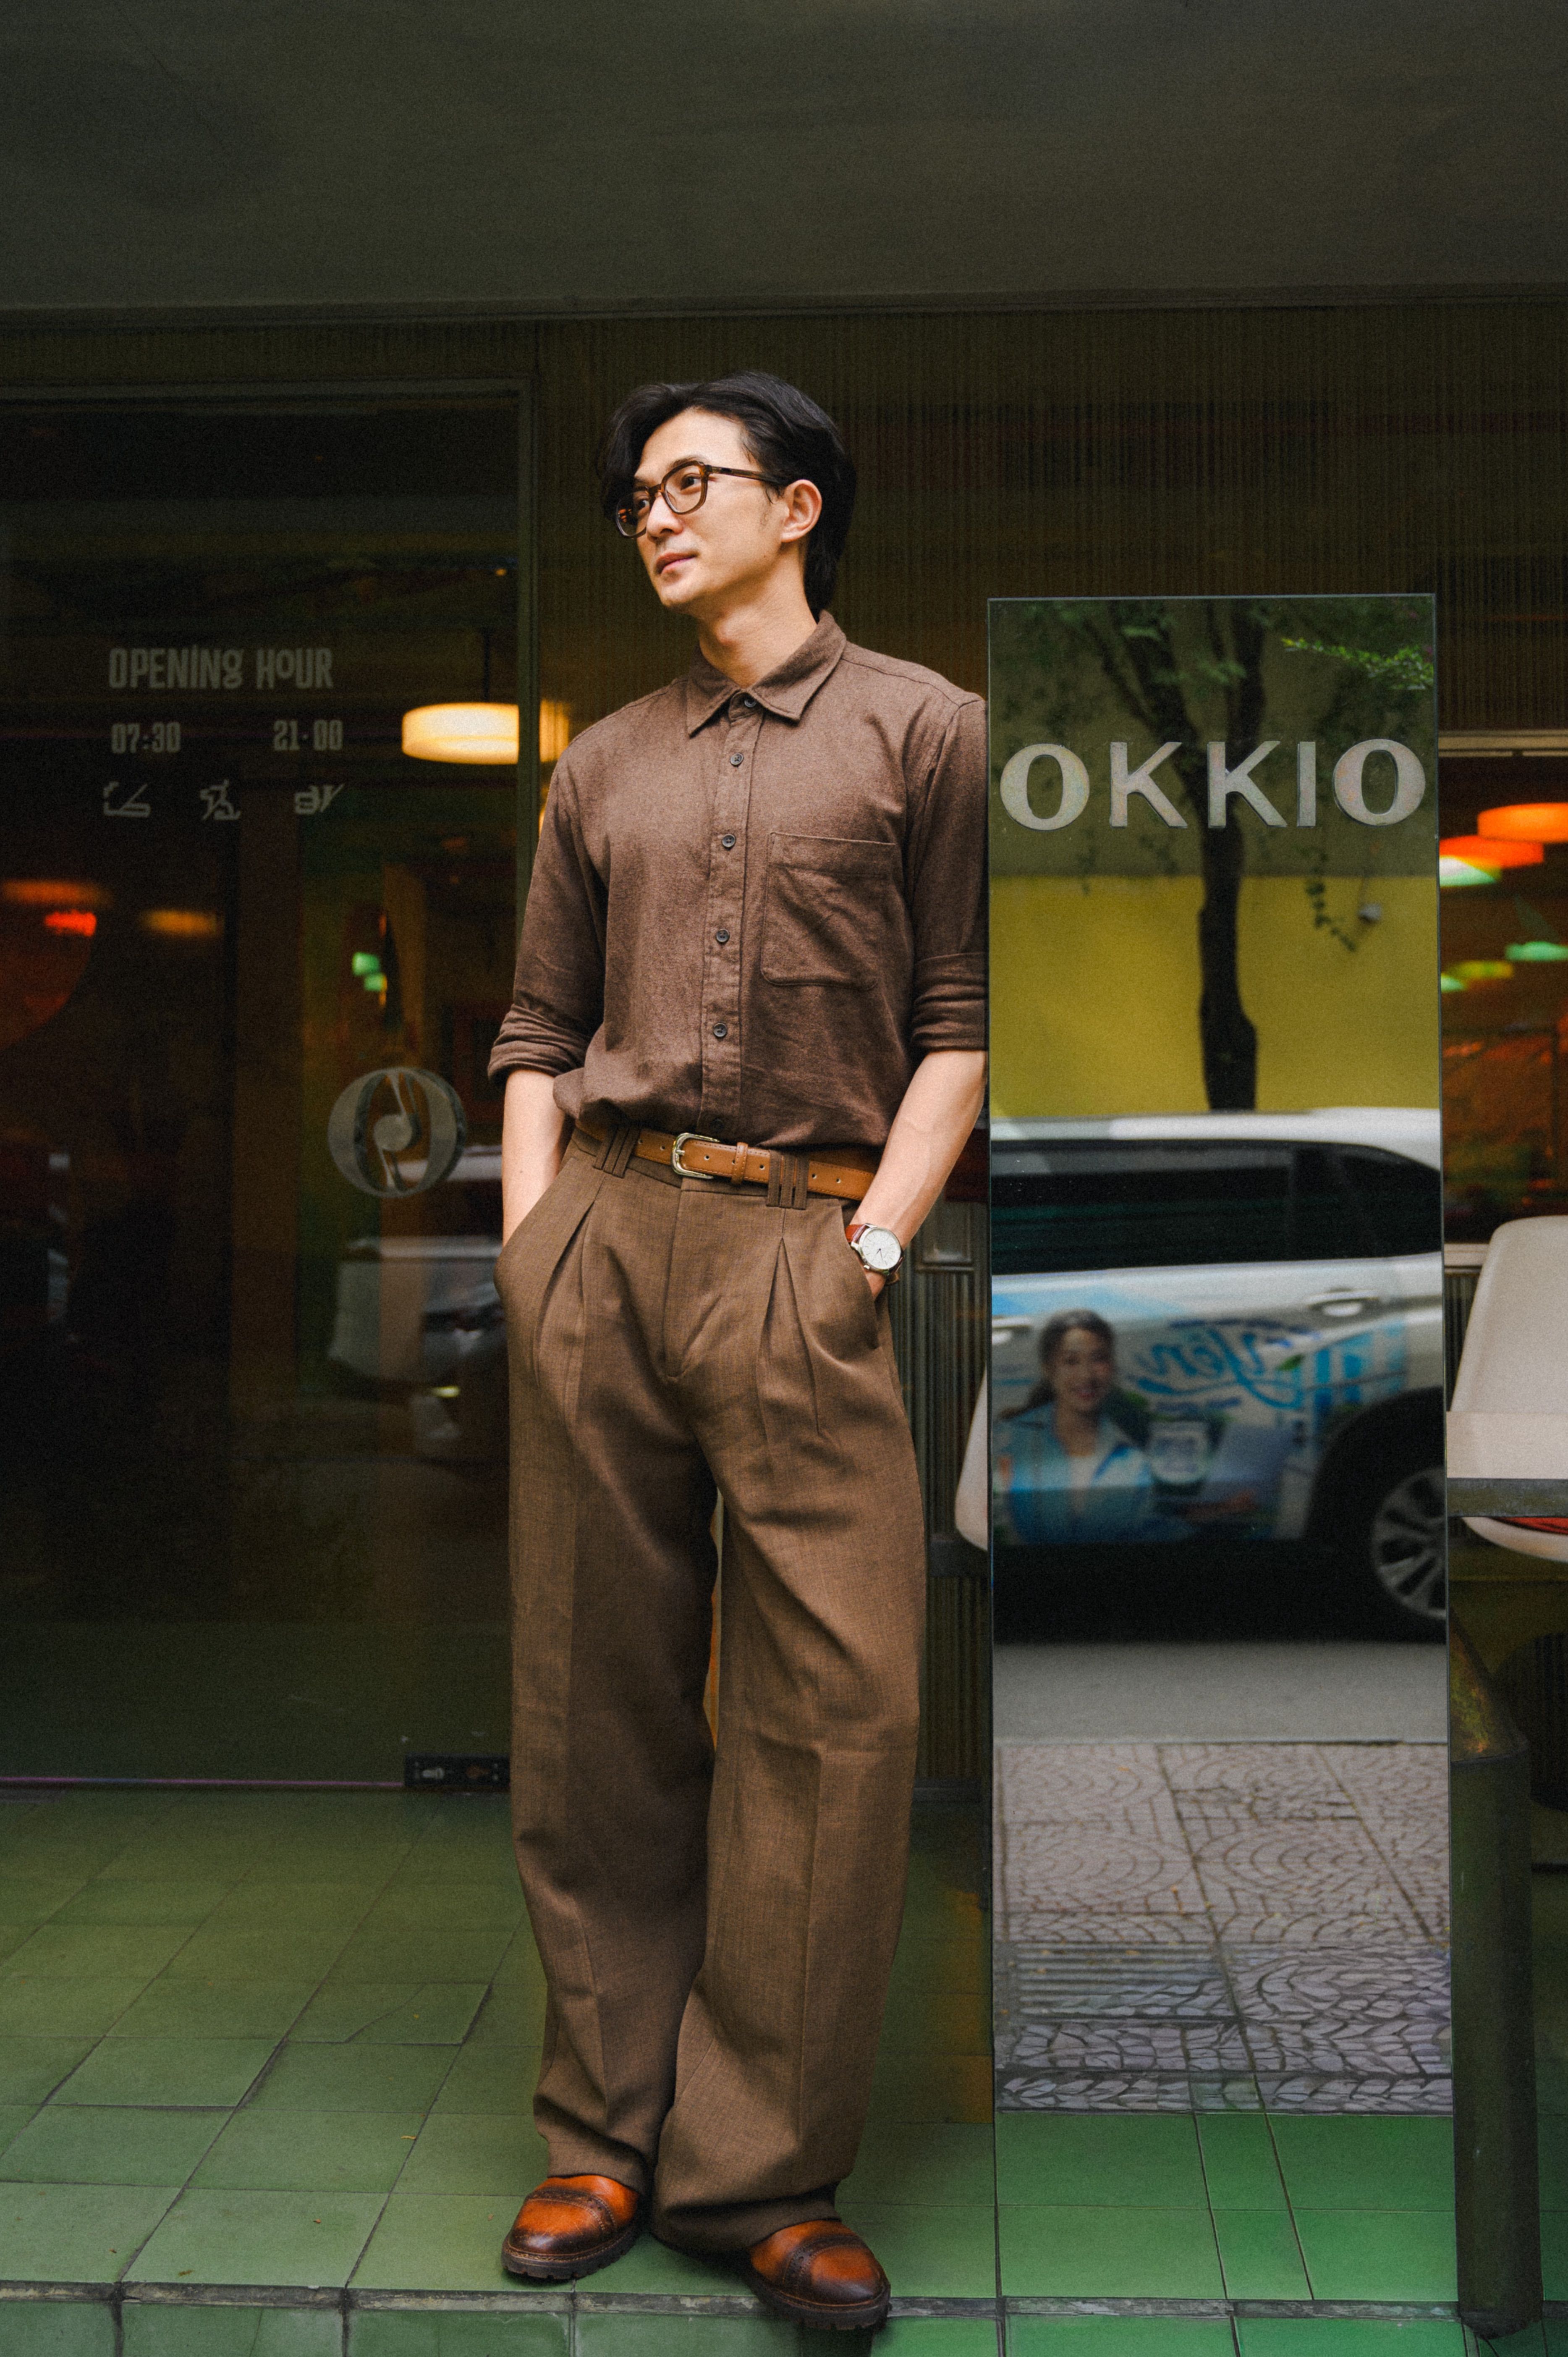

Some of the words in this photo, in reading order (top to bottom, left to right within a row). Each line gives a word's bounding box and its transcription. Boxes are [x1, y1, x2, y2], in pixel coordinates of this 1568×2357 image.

[256, 648, 334, 689] HOUR
[111, 721, 181, 754] 07:30
[1000, 739, 1426, 831] OKKIO
